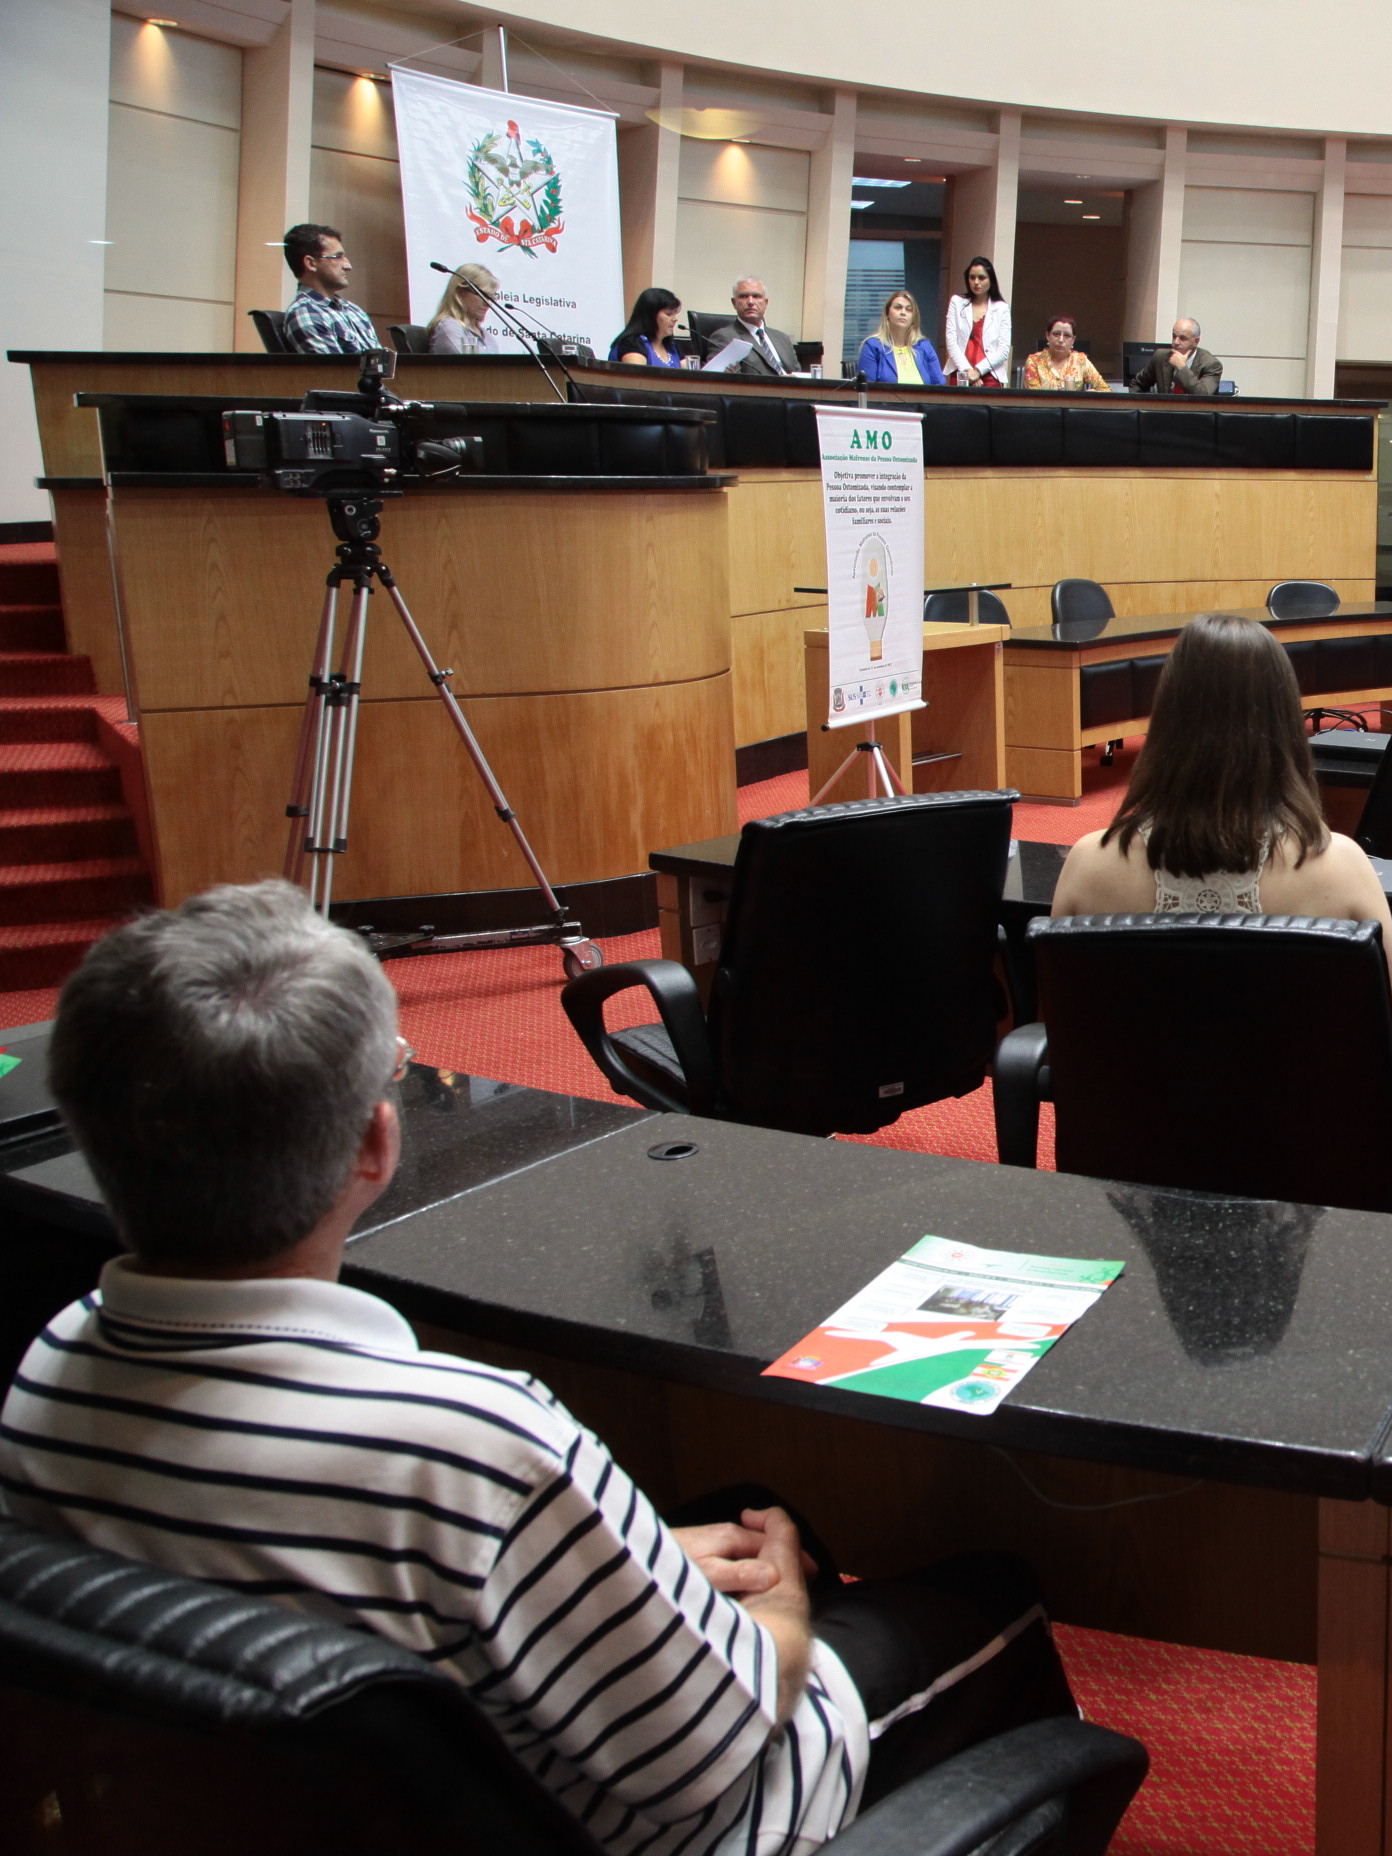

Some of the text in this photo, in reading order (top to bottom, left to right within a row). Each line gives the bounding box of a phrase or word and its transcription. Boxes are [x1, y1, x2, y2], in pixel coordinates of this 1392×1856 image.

[476, 228, 500, 238] ESTADO
[494, 291, 577, 309] bleia Legislativa
[502, 327, 515, 337] de
[850, 429, 893, 450] AMO
[834, 471, 854, 481] Objetiva
[854, 473, 875, 481] promover
[879, 472, 901, 482] integração
[835, 506, 859, 515] cotidiano,
